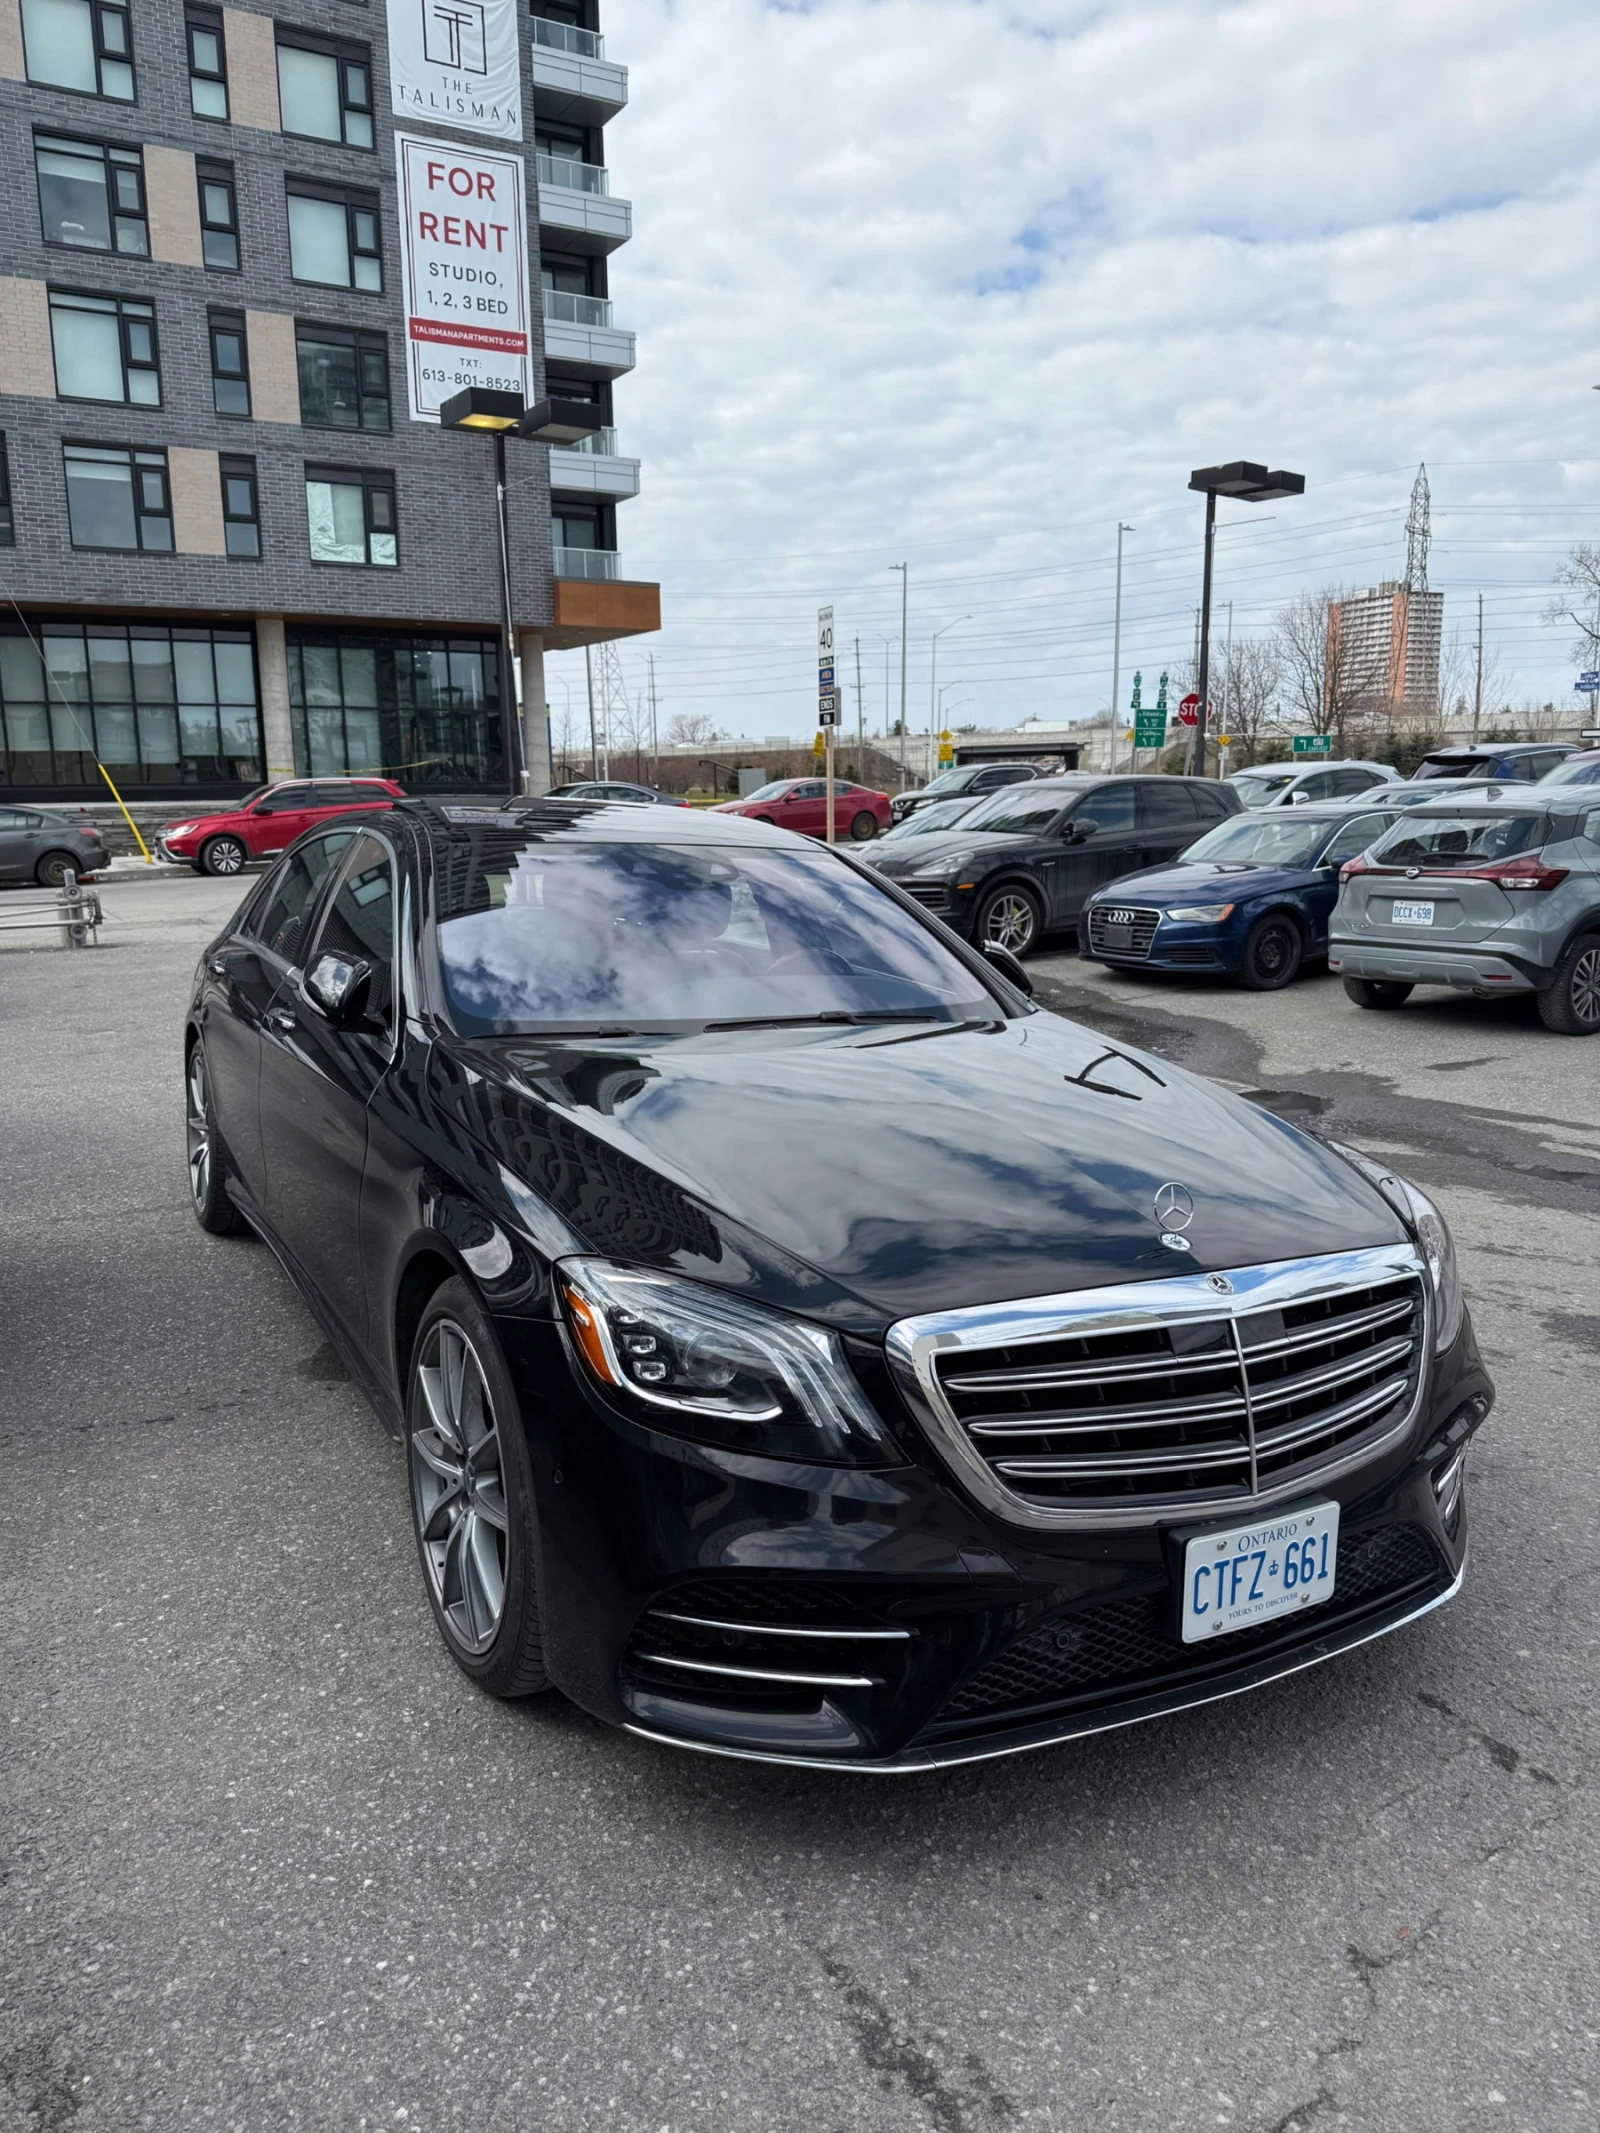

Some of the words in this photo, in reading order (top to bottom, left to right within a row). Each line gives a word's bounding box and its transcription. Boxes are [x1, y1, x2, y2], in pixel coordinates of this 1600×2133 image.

[442, 76, 473, 95] THE
[397, 84, 517, 125] TALISMAN
[427, 161, 497, 202] FOR
[419, 211, 509, 253] RENT
[429, 262, 504, 288] STUDIO,
[427, 290, 438, 307] 1,
[443, 292, 458, 310] 2,
[462, 295, 473, 310] 3
[477, 298, 509, 315] BED
[413, 325, 525, 348] TALISMANAPARTMENTS.COM
[459, 357, 483, 369] TXT:
[422, 368, 521, 392] 613-801-8523
[820, 627, 833, 650] 40
[820, 699, 834, 711] ENDS
[1238, 1523, 1298, 1552] ONTARIO
[1193, 1549, 1267, 1616] CTFZ
[1283, 1532, 1329, 1589] 661
[1228, 1606, 1253, 1620] YOURS
[1254, 1603, 1264, 1612] TO
[1265, 1592, 1299, 1610] DISCOVER
